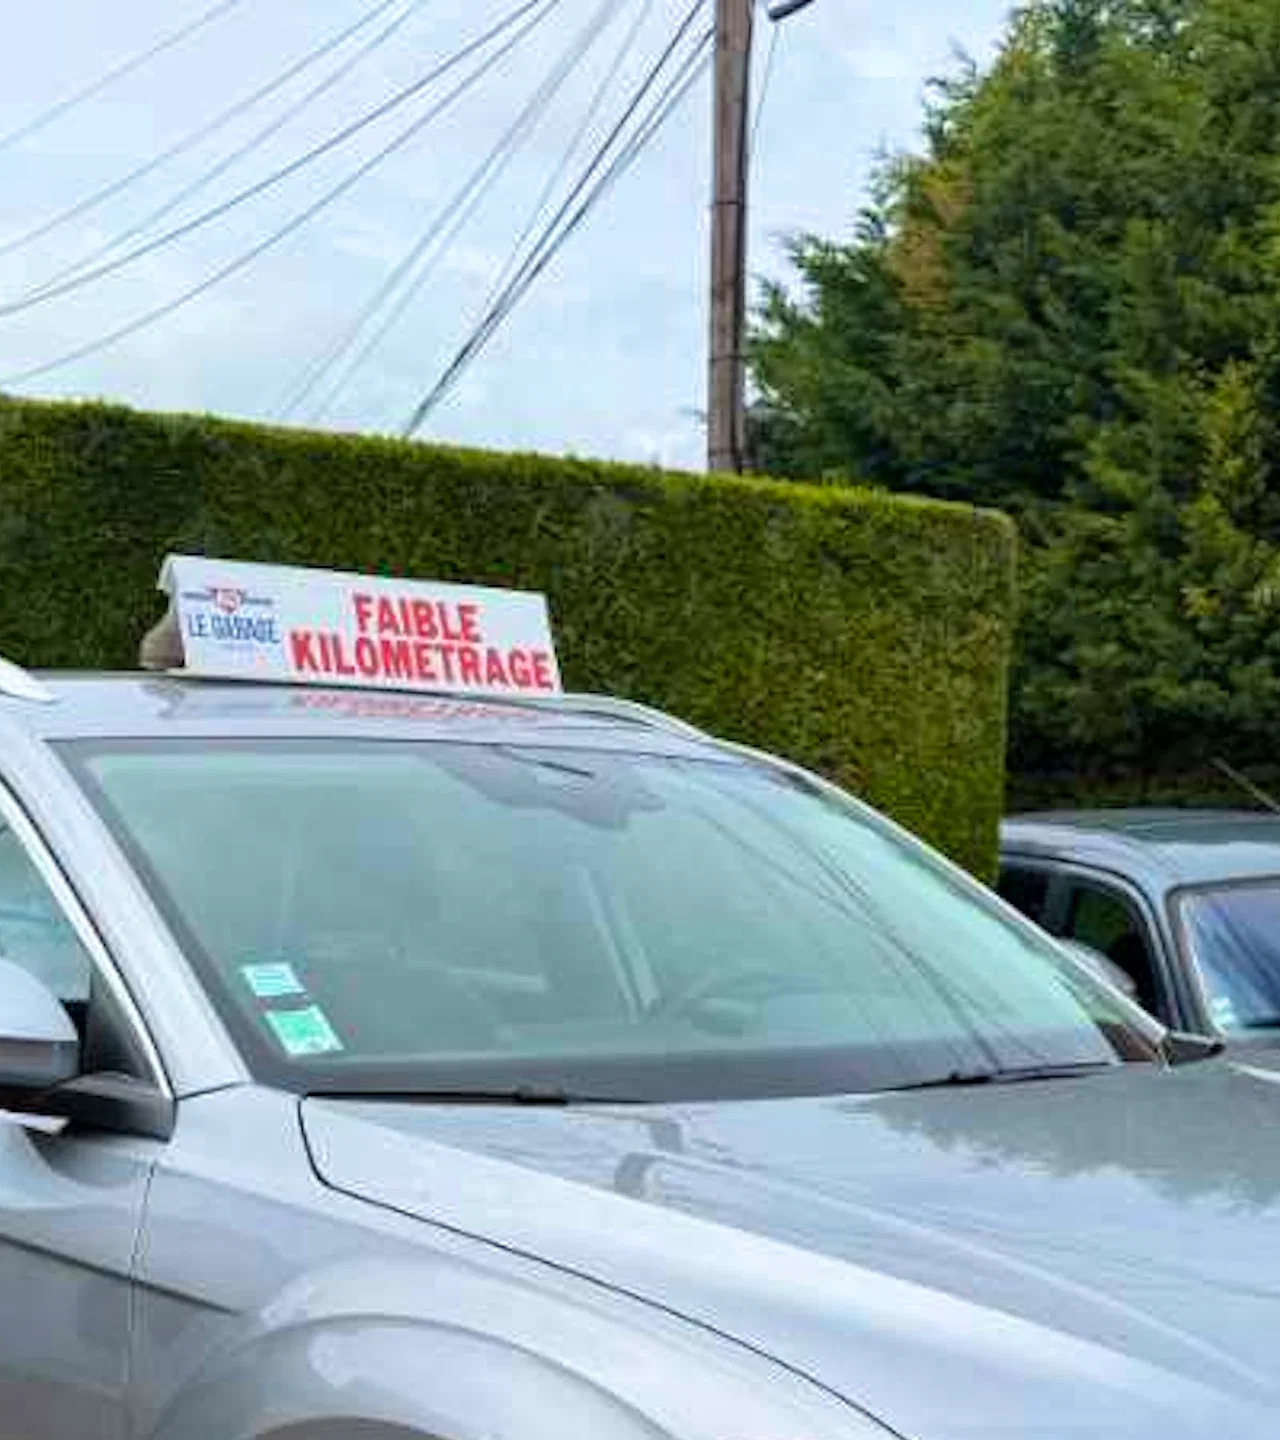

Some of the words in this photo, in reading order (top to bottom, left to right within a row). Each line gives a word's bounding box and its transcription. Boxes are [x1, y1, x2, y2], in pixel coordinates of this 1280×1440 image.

[188, 613, 209, 637] LE
[353, 593, 481, 642] FAIBLE
[290, 630, 554, 690] KILOMETRAGE
